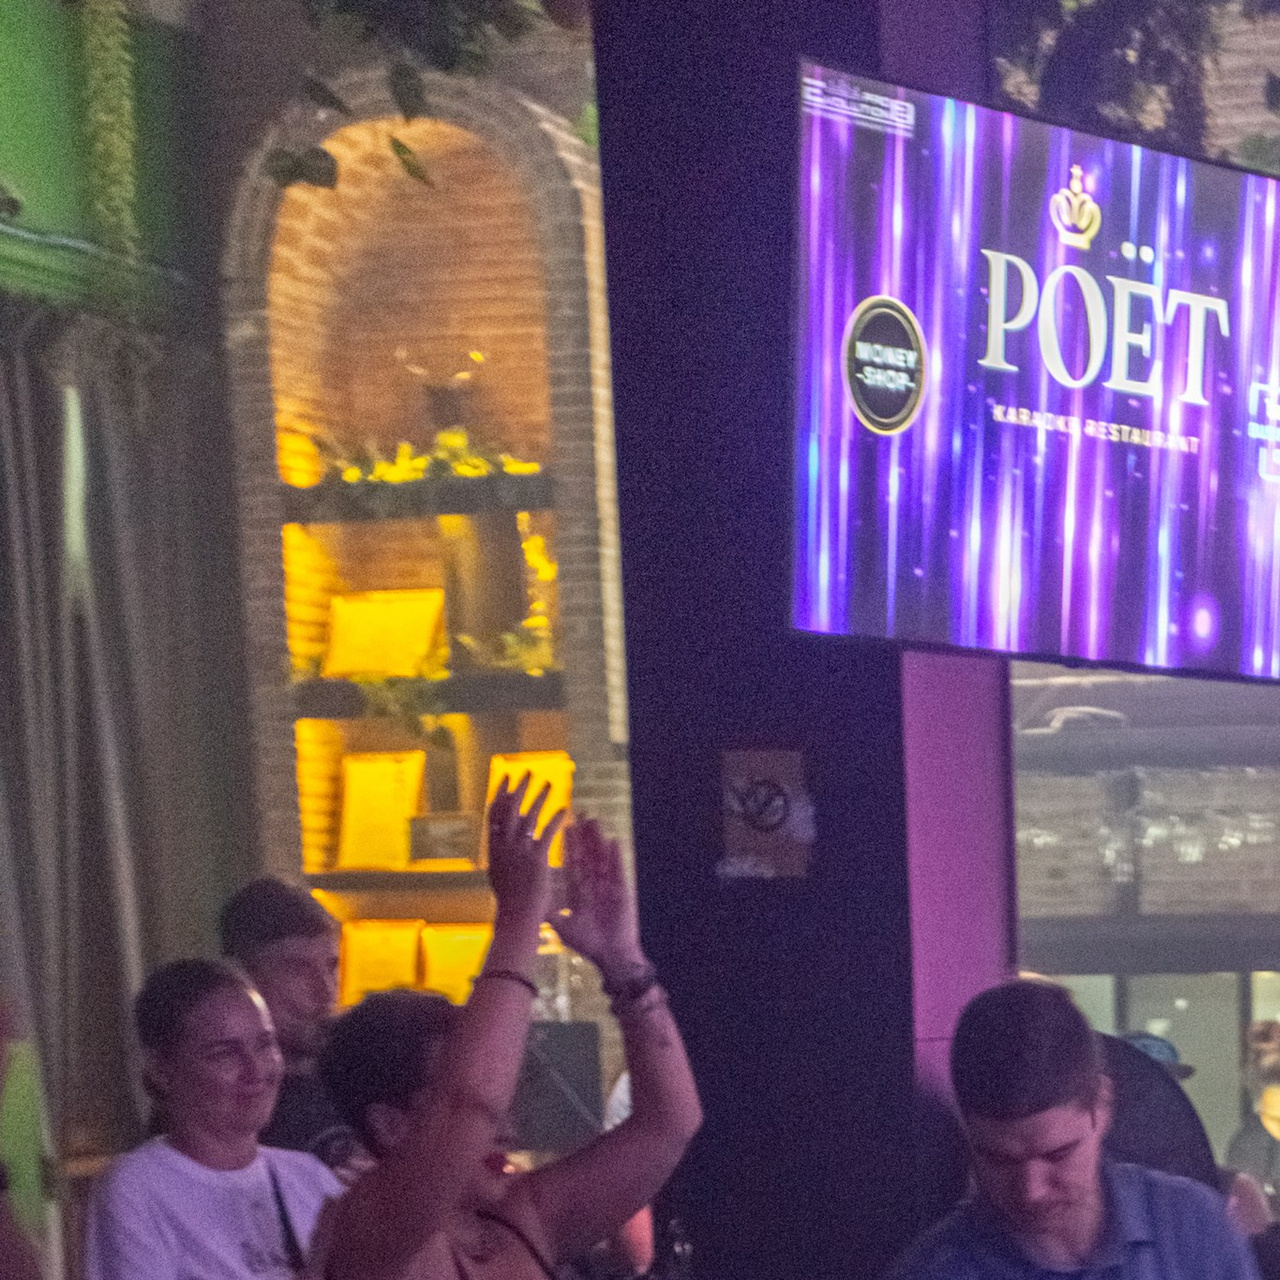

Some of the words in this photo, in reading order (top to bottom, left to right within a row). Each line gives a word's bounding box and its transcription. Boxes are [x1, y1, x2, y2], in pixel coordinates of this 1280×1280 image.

[977, 240, 1231, 406] POËT
[993, 404, 1082, 434] KARAOKE
[1084, 418, 1200, 455] RESTAURANT
